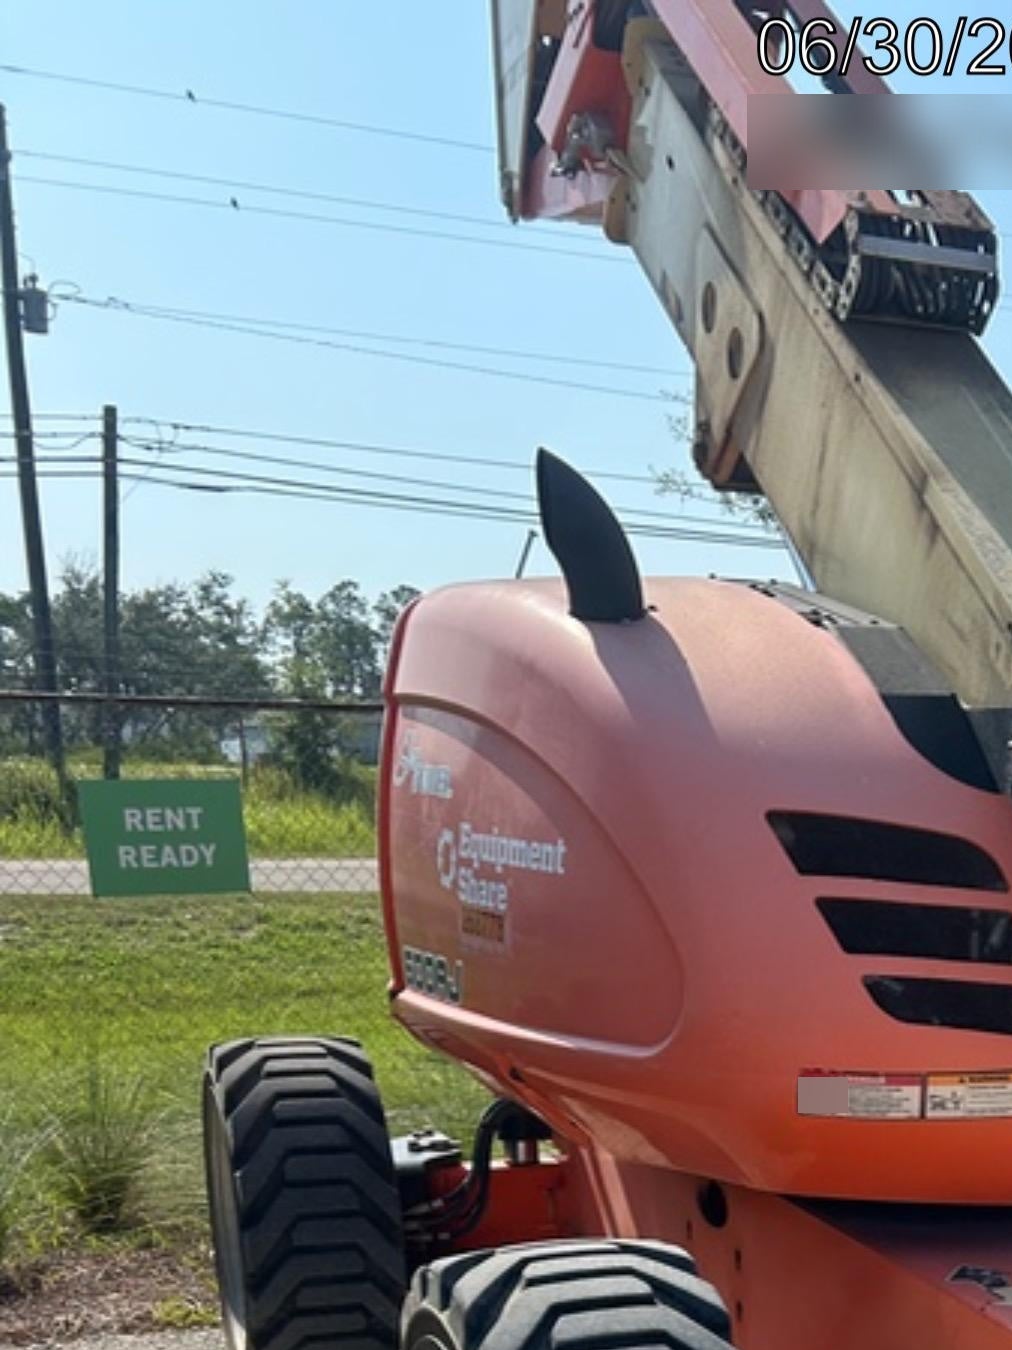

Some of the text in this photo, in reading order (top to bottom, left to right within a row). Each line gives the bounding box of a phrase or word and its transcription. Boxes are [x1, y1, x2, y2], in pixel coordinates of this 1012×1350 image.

[124, 807, 203, 831] RENT
[118, 843, 216, 868] READY
[459, 822, 567, 874] Equipment
[458, 865, 509, 911] Share
